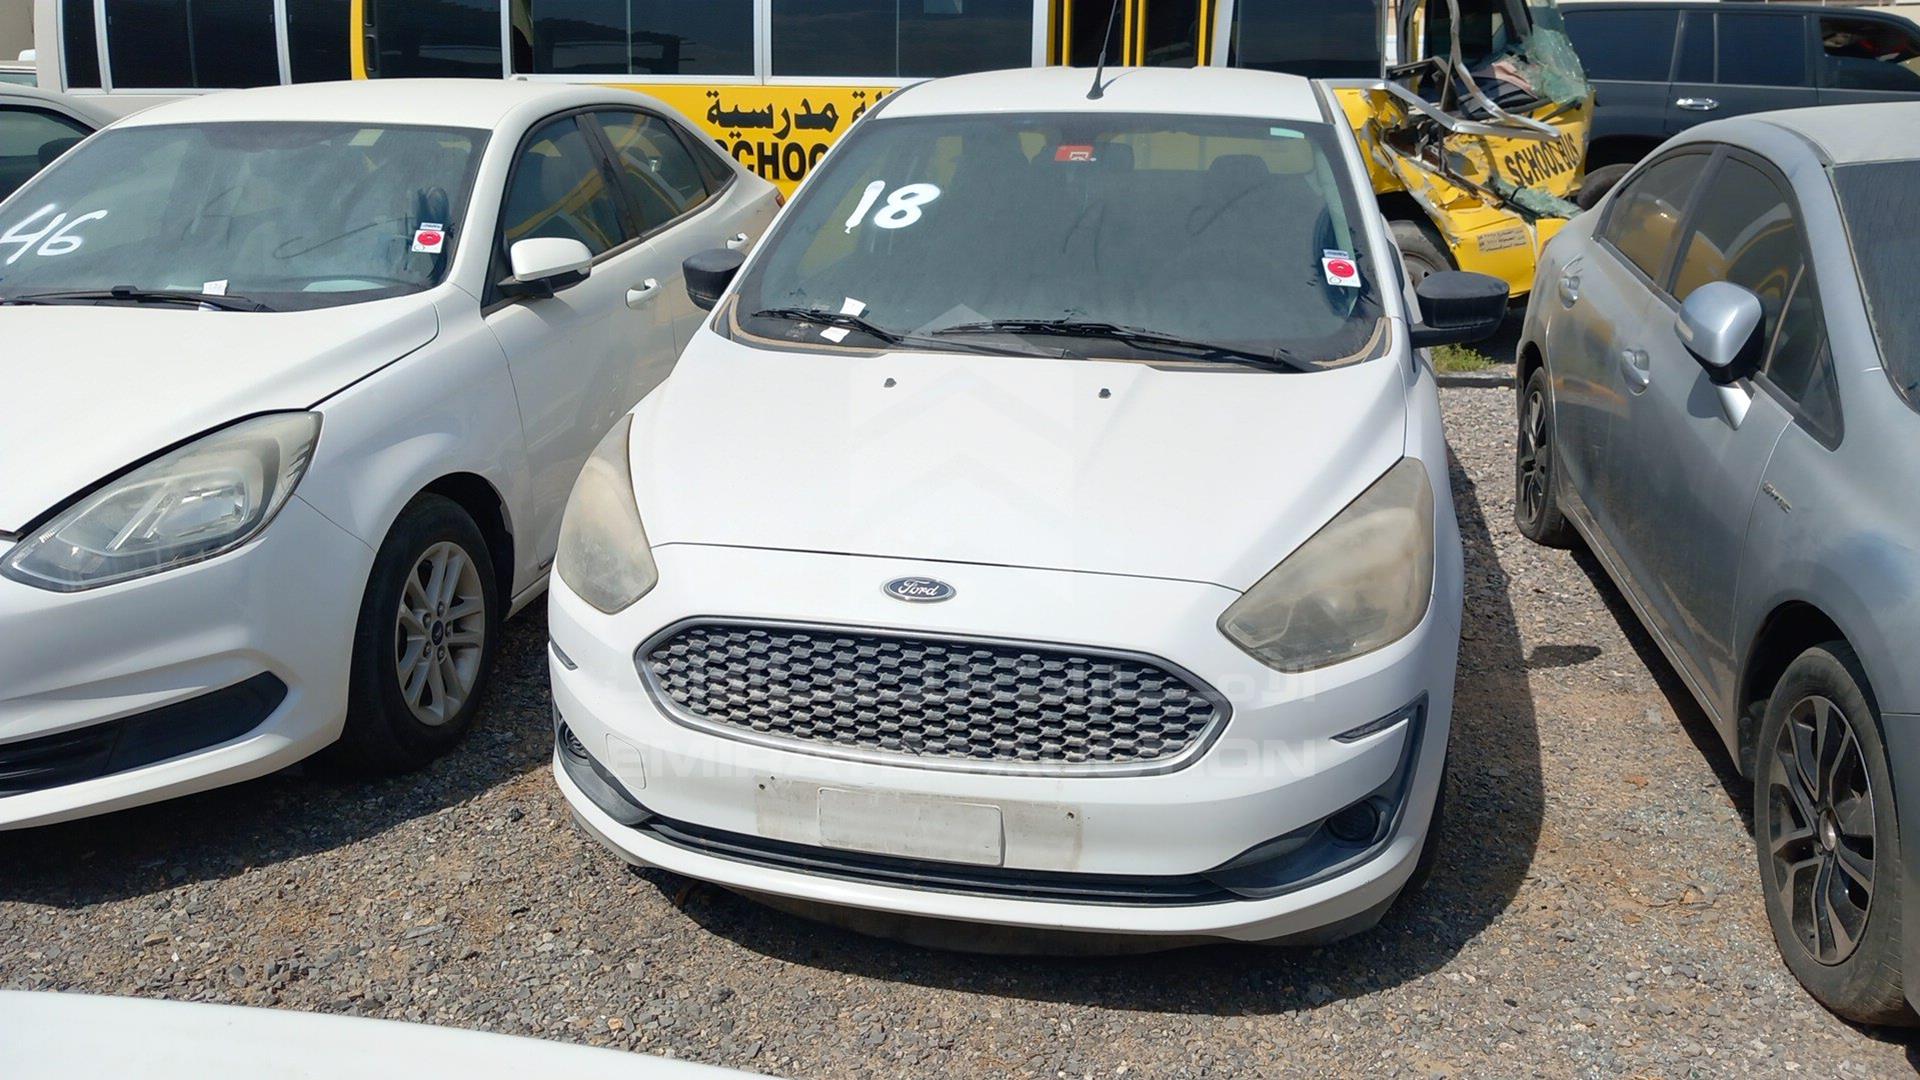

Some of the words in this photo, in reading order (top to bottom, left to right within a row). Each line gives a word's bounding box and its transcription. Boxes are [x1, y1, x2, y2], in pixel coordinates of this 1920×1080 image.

[706, 90, 839, 140] مدرسية
[1505, 141, 1566, 188] SCHOOL
[845, 180, 941, 234] 18
[0, 203, 108, 265] 46
[898, 579, 939, 596] Ford
